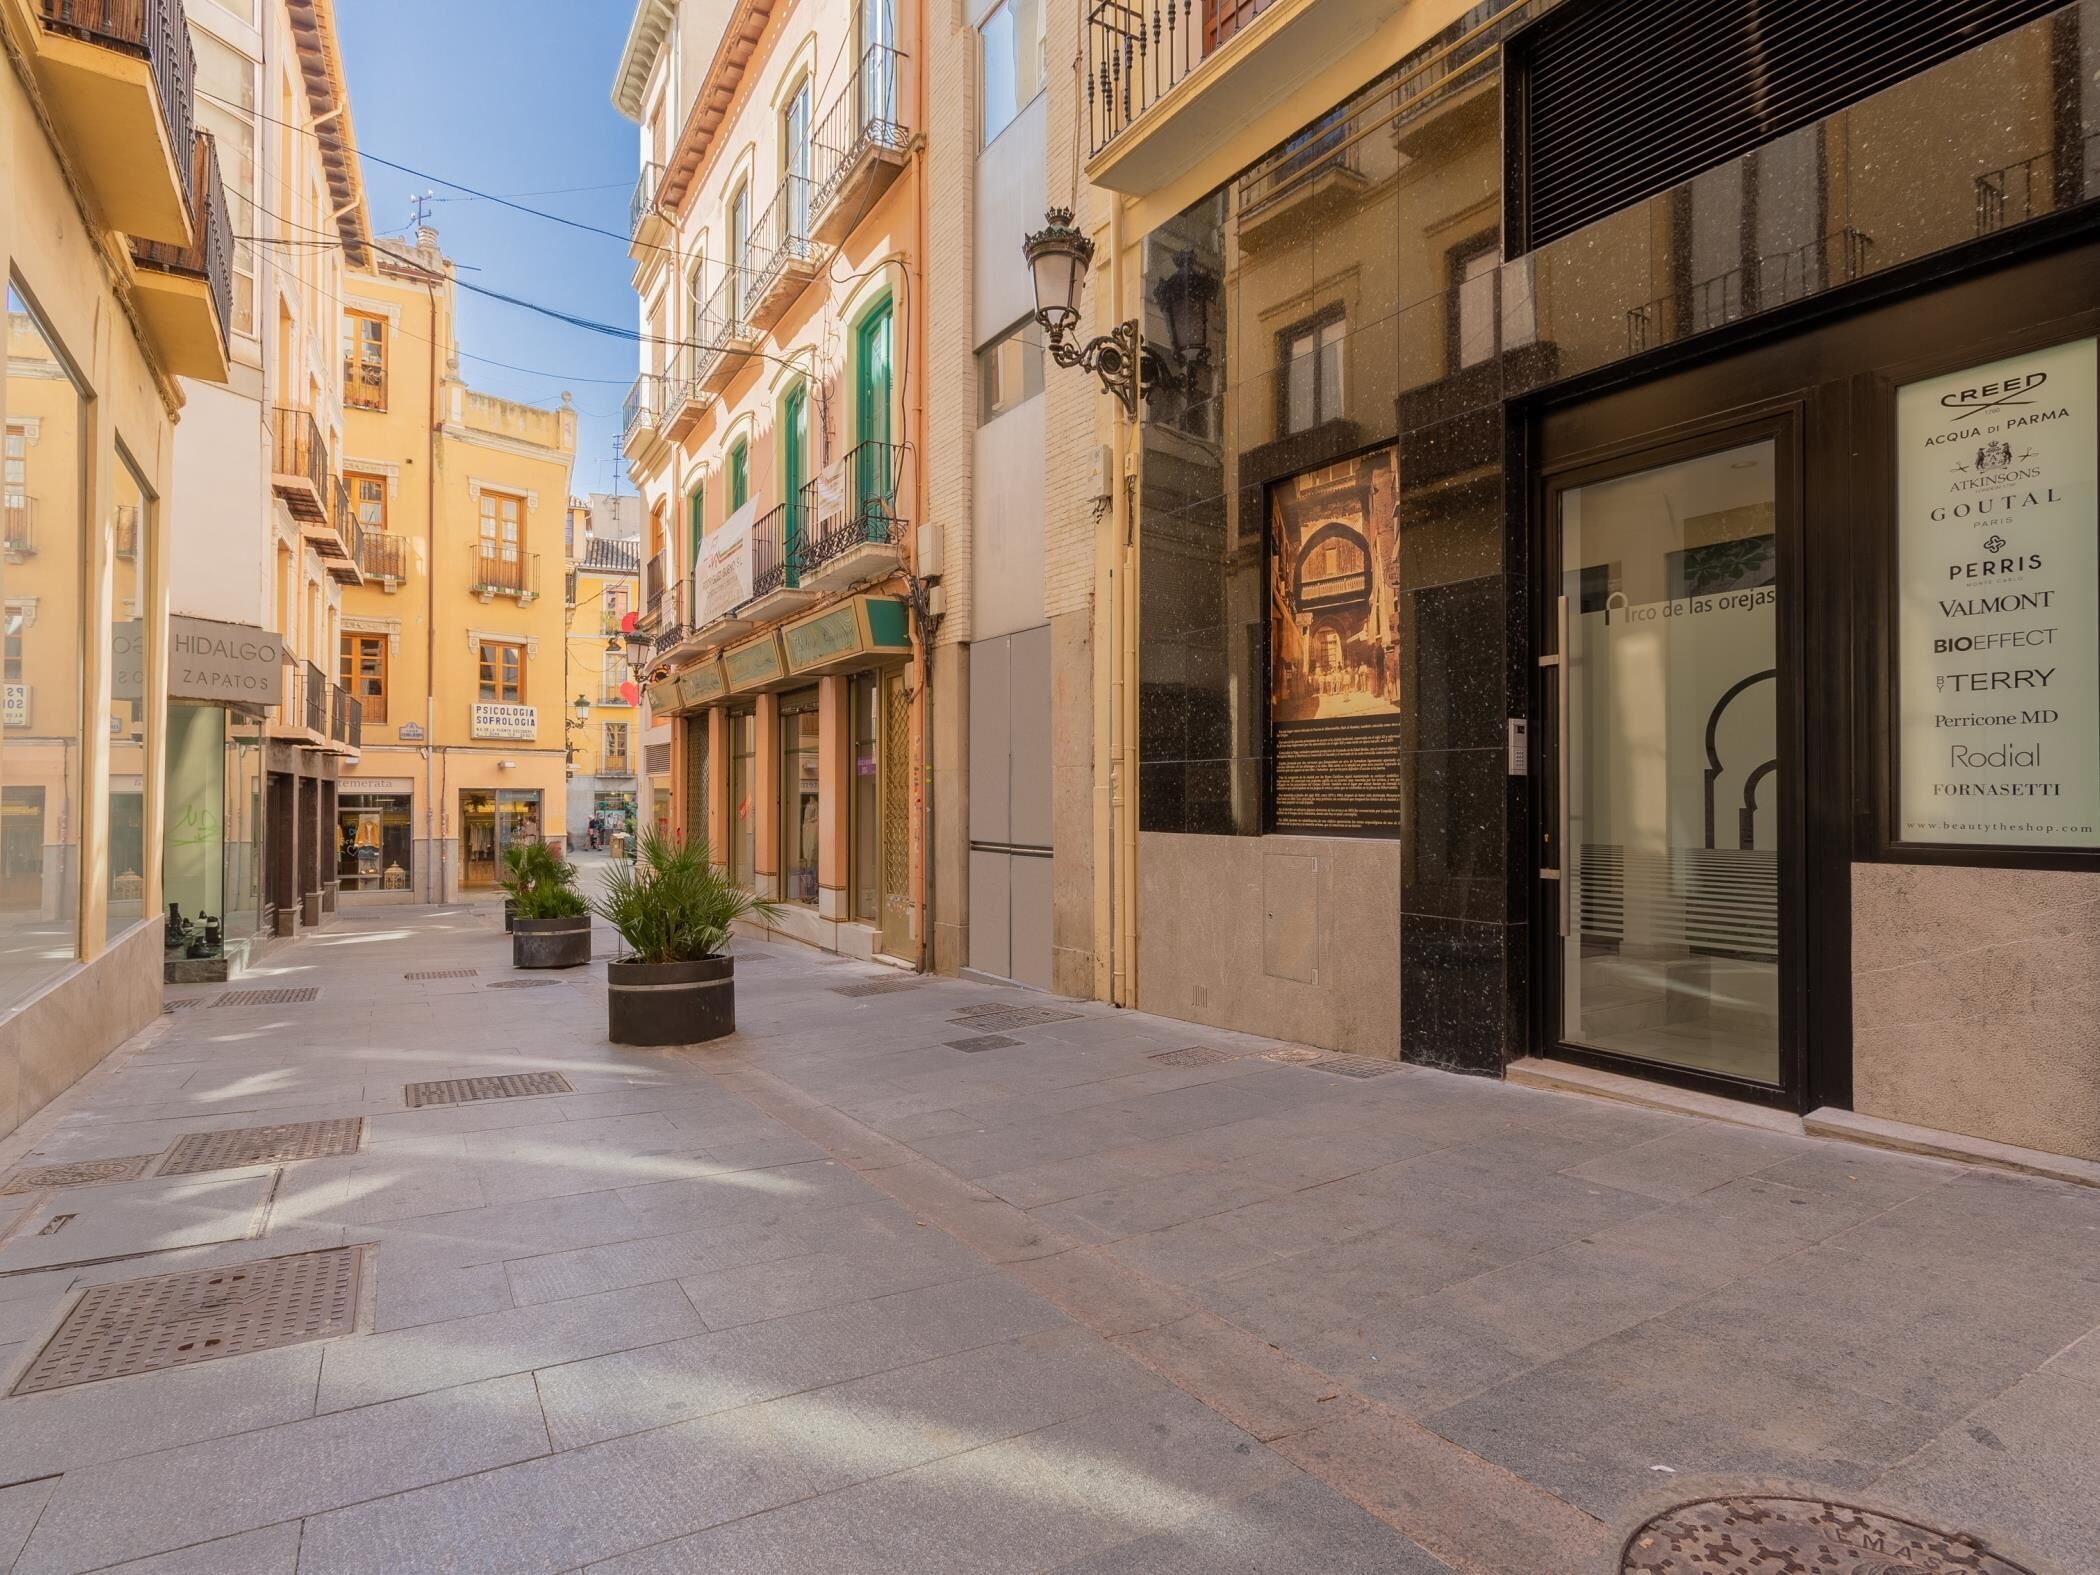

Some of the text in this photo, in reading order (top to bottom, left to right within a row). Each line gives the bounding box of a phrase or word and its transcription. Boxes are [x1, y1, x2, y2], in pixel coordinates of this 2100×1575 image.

[1941, 372, 2047, 407] CREED
[1924, 408, 2070, 447] ACQUA DI PARMA
[1950, 466, 2041, 492] ATKINSONS
[1930, 488, 2062, 522] GOUTAL
[1973, 516, 2014, 528] PARIS
[1950, 554, 2042, 580] PERRIS
[1663, 600, 1683, 618] de
[1689, 596, 1713, 615] las
[1718, 588, 1776, 611] orejas
[1939, 591, 2055, 618] VALMONT
[175, 634, 275, 662] HIDALGO
[1934, 628, 2059, 654] BIOEFFECT
[183, 669, 268, 691] ZAPATOS
[1947, 668, 2056, 692] TERRY
[476, 705, 534, 717] PSICOLOGIA
[476, 716, 535, 727] SOFROLOGIA
[1935, 709, 2059, 728] Perricone MD
[1951, 743, 2040, 768] Rodial
[1931, 783, 2061, 796] FORNASETTI
[1907, 821, 2092, 834] www.beautytheshop.com
